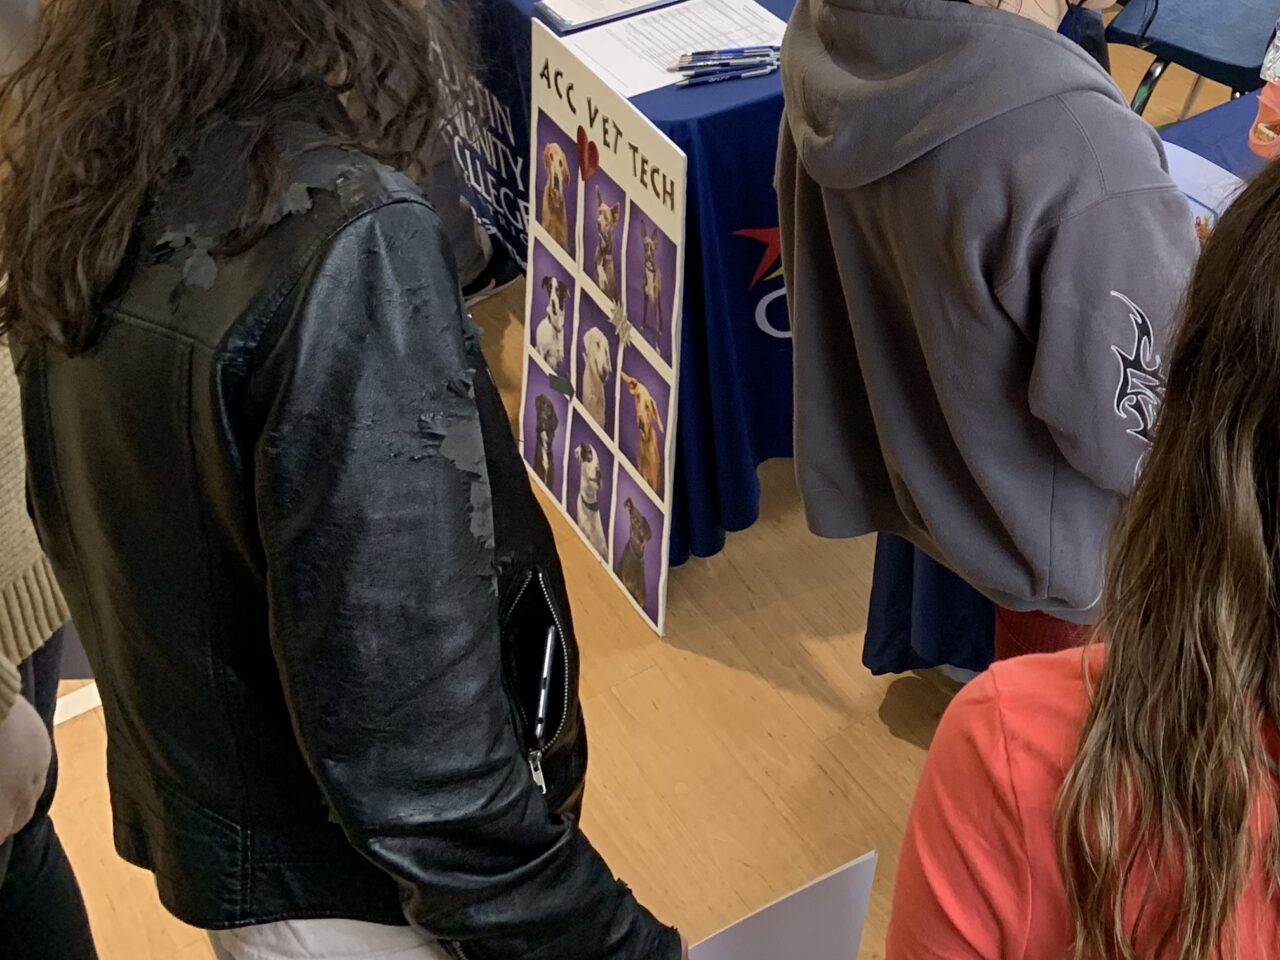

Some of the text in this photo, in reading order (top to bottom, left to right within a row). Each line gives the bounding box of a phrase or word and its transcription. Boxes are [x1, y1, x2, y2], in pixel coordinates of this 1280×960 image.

[539, 57, 675, 211] ACC VET TECH
